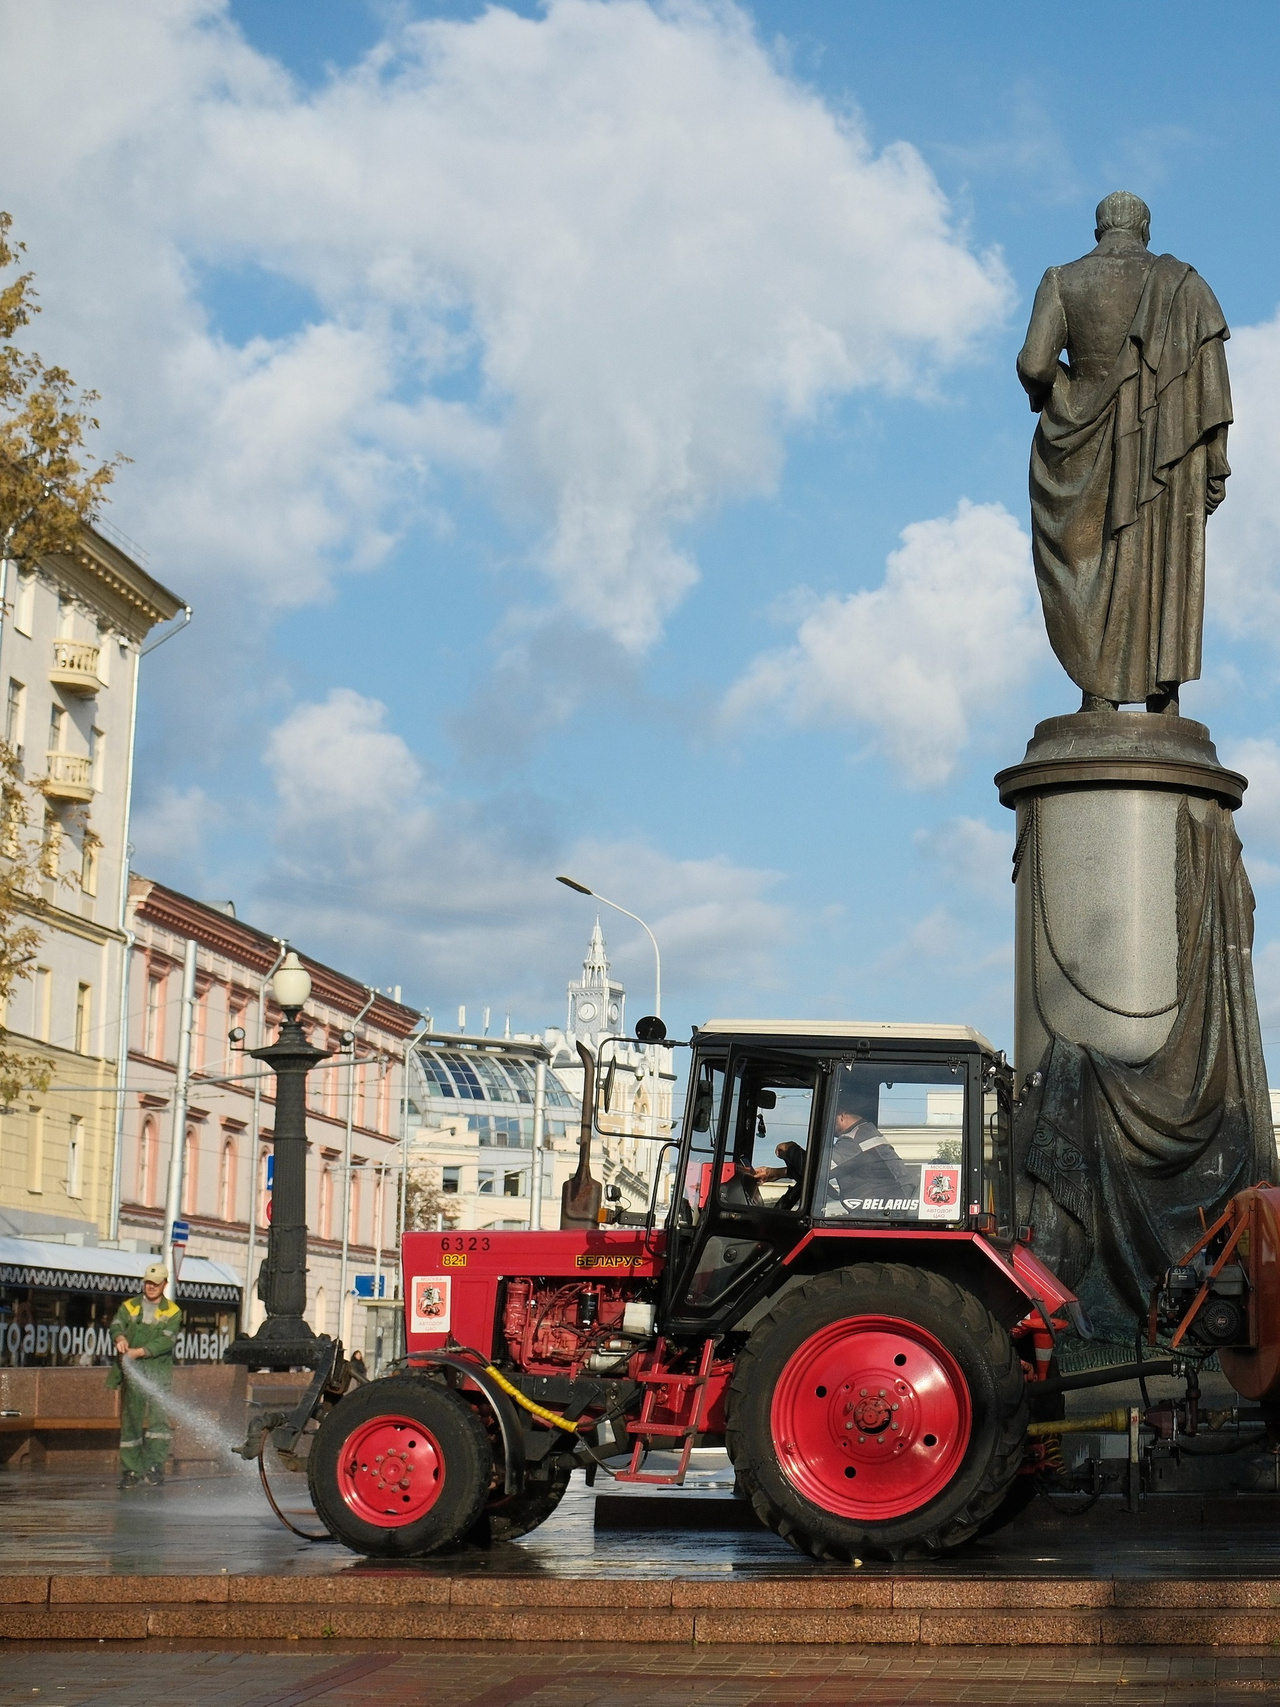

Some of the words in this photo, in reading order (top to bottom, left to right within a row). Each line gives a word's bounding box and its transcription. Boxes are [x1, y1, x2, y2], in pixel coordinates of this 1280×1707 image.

[862, 1198, 919, 1210] BELARUS
[441, 1237, 490, 1251] 6323
[575, 1255, 643, 1268] БЕЛАРУС
[23, 1323, 118, 1357] автоном
[174, 1326, 230, 1360] амвай
